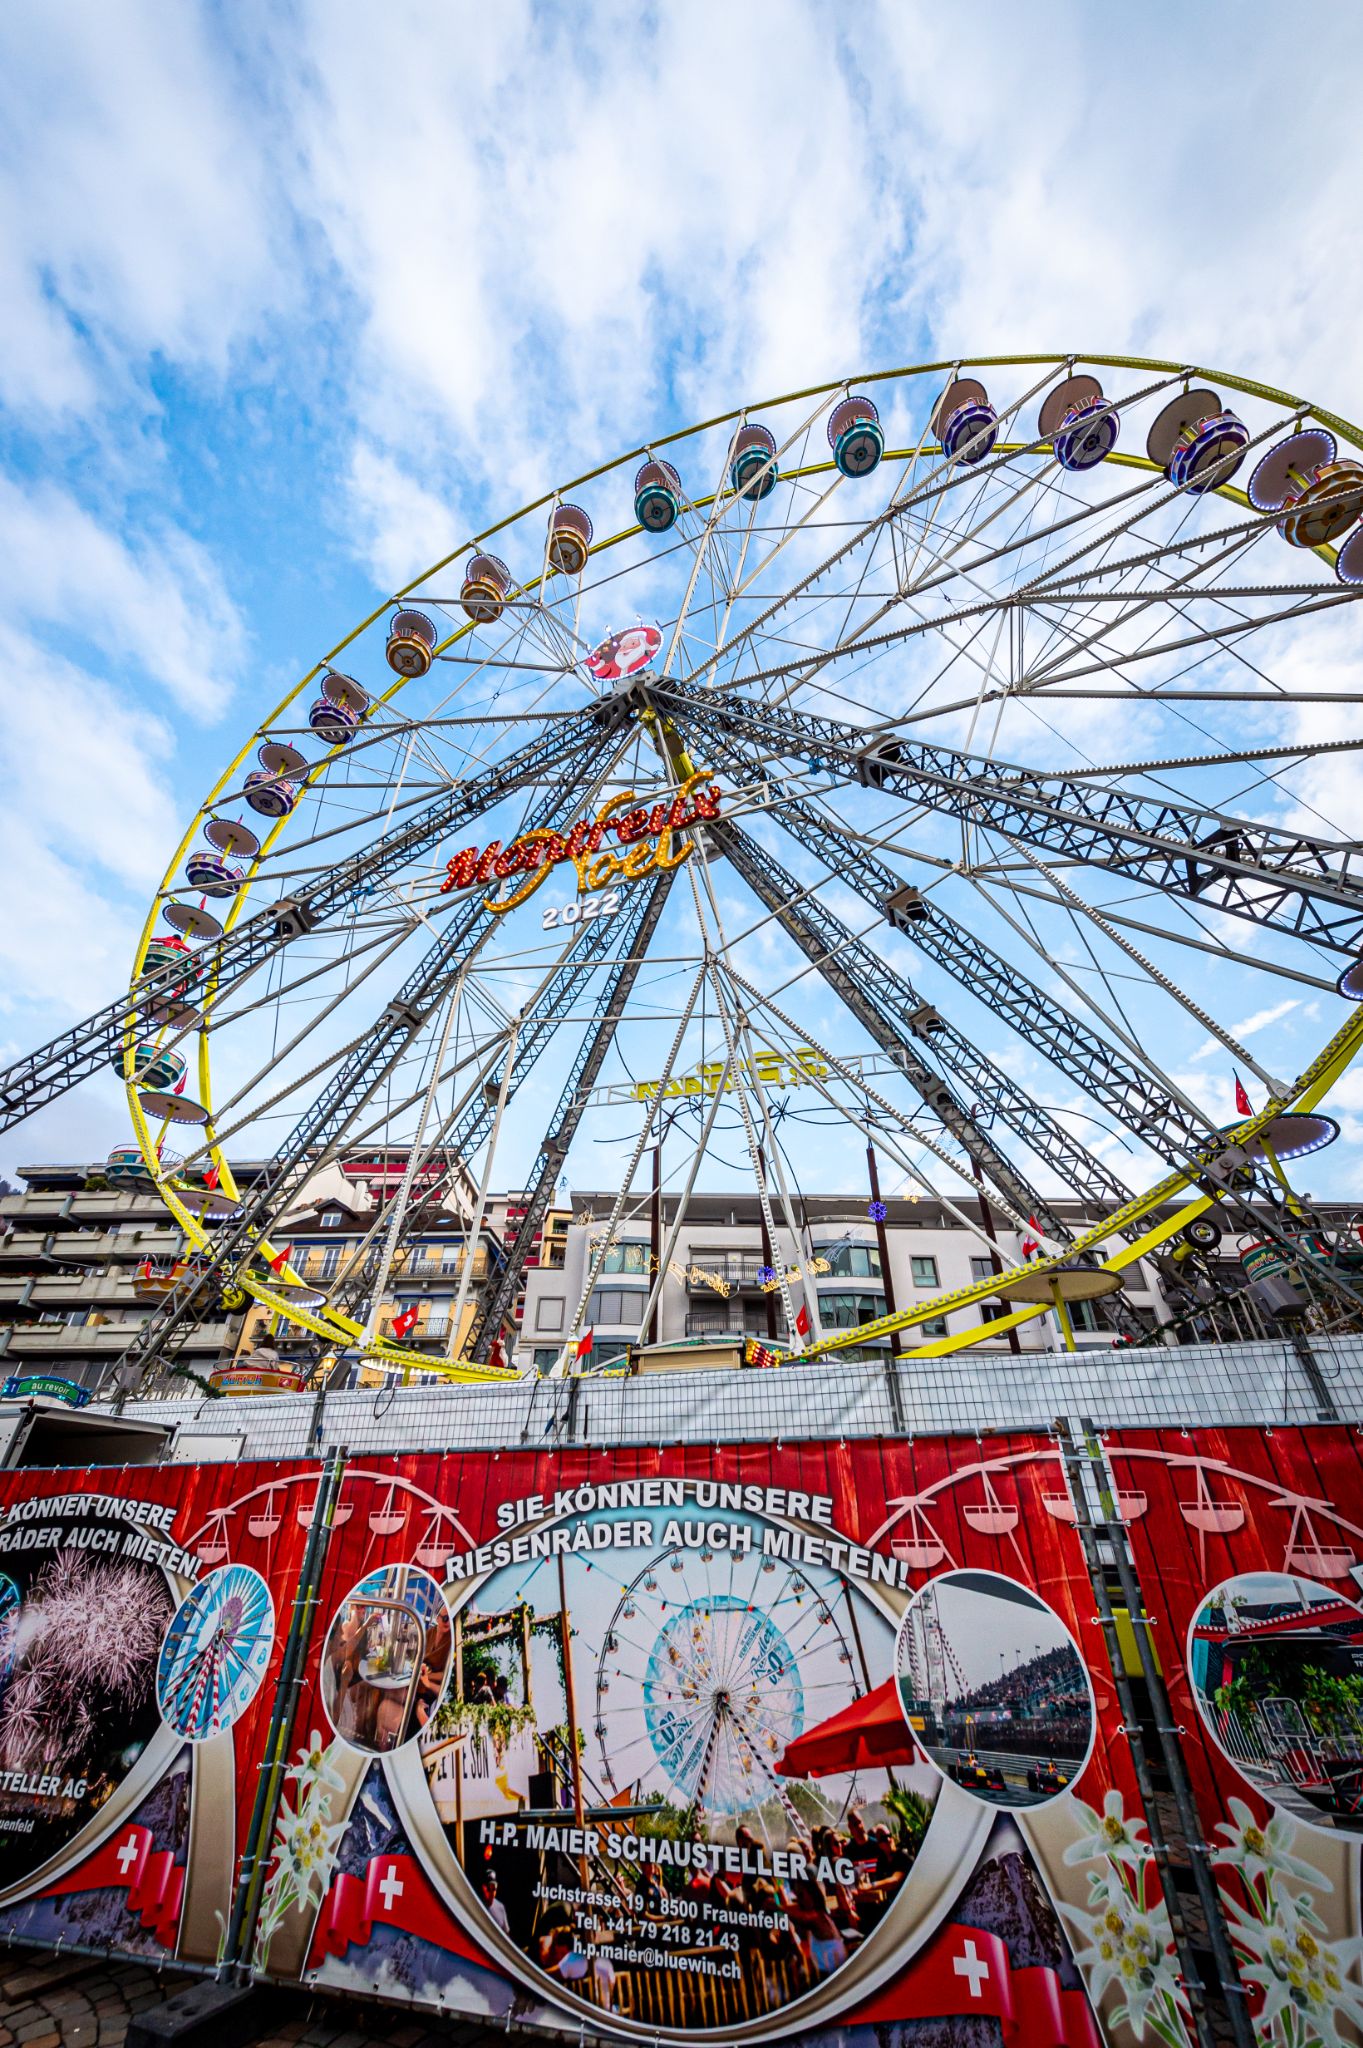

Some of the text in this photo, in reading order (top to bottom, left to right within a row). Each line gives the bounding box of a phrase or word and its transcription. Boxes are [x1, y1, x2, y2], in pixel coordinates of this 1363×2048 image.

[542, 893, 620, 931] 2022
[31, 1382, 70, 1395] au revoir
[7, 1496, 93, 1523] KÖNNEN
[95, 1498, 177, 1531] UNSERE
[496, 1481, 833, 1528] SIE KÖNNEN UNSERE
[63, 1527, 121, 1553] AUCH
[120, 1533, 203, 1581] MIETEN!
[445, 1520, 909, 1590] RIESENRÄDER AUCH MIETEN!
[61, 1778, 87, 1800] AG
[479, 1820, 855, 1885] H.P. MAIER SCHAUSTELLER AG
[532, 1881, 790, 1931] Juchstrasse 19 8500 Frauenfeld
[575, 1911, 740, 1952] Tel. +41 79 218 21 43
[573, 1937, 742, 1980] h.p.maier@bluewin.ch
